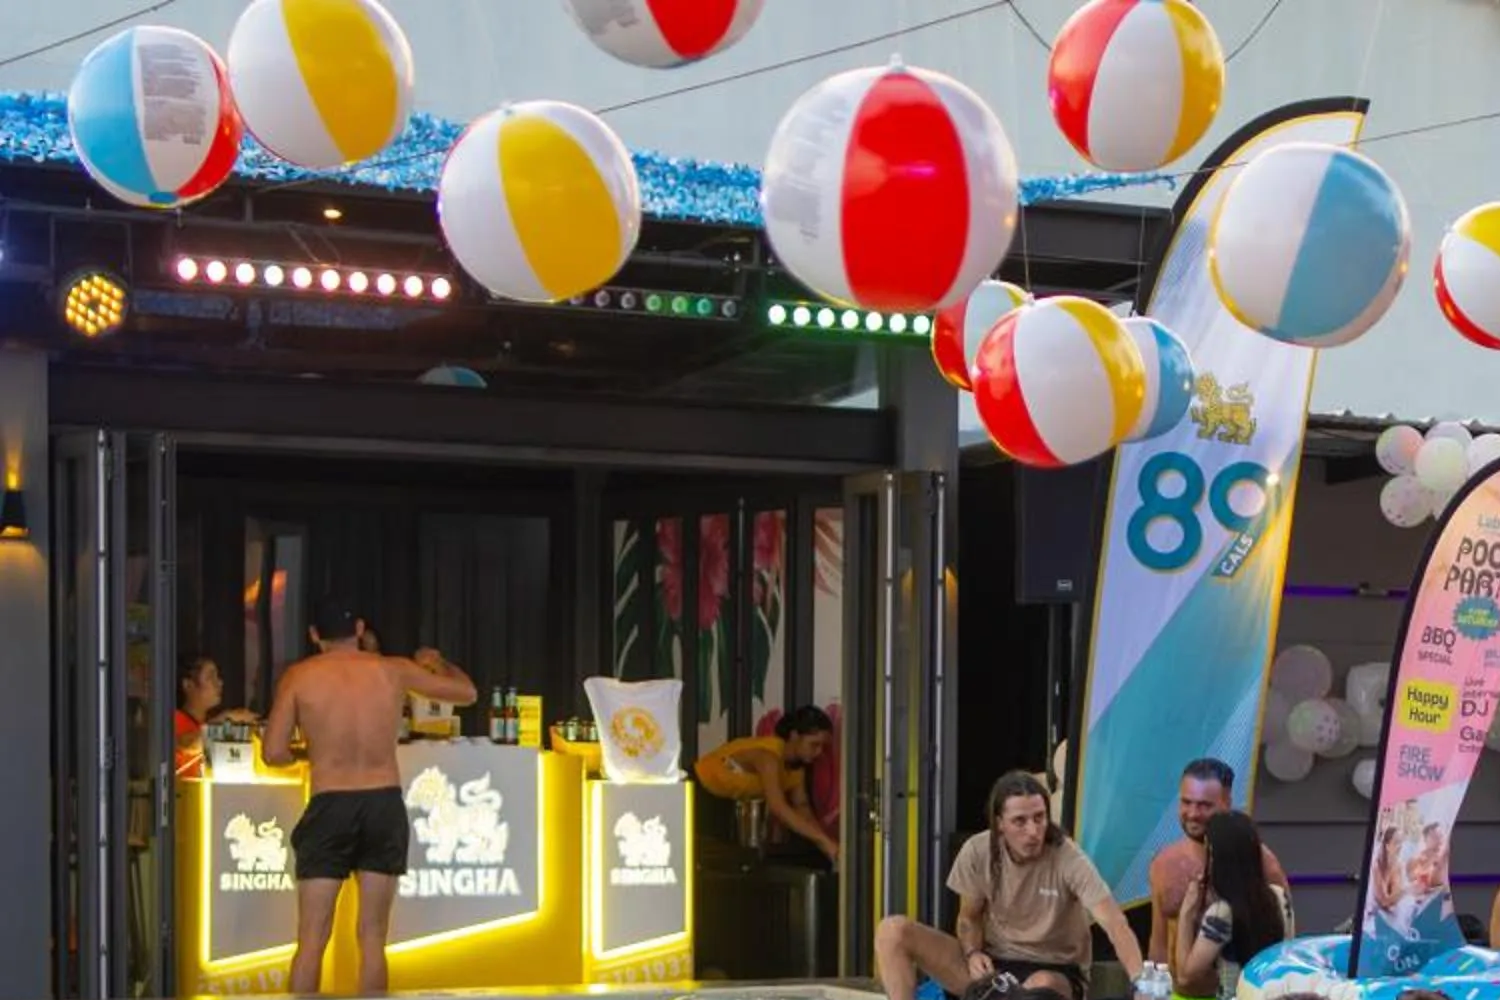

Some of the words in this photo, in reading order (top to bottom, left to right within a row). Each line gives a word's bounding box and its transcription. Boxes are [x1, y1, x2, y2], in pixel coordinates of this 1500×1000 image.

[1126, 451, 1283, 577] 89
[1219, 534, 1254, 577] CALS
[1421, 626, 1456, 653] BBQ
[1418, 650, 1453, 666] SPECIAL
[1407, 687, 1449, 710] Happy
[1409, 708, 1442, 724] Hour
[1461, 700, 1489, 717] DJ
[1400, 745, 1431, 764] FIRE
[1398, 763, 1444, 782] SHOW
[220, 872, 295, 891] SINGHA
[397, 867, 520, 896] SINGHA
